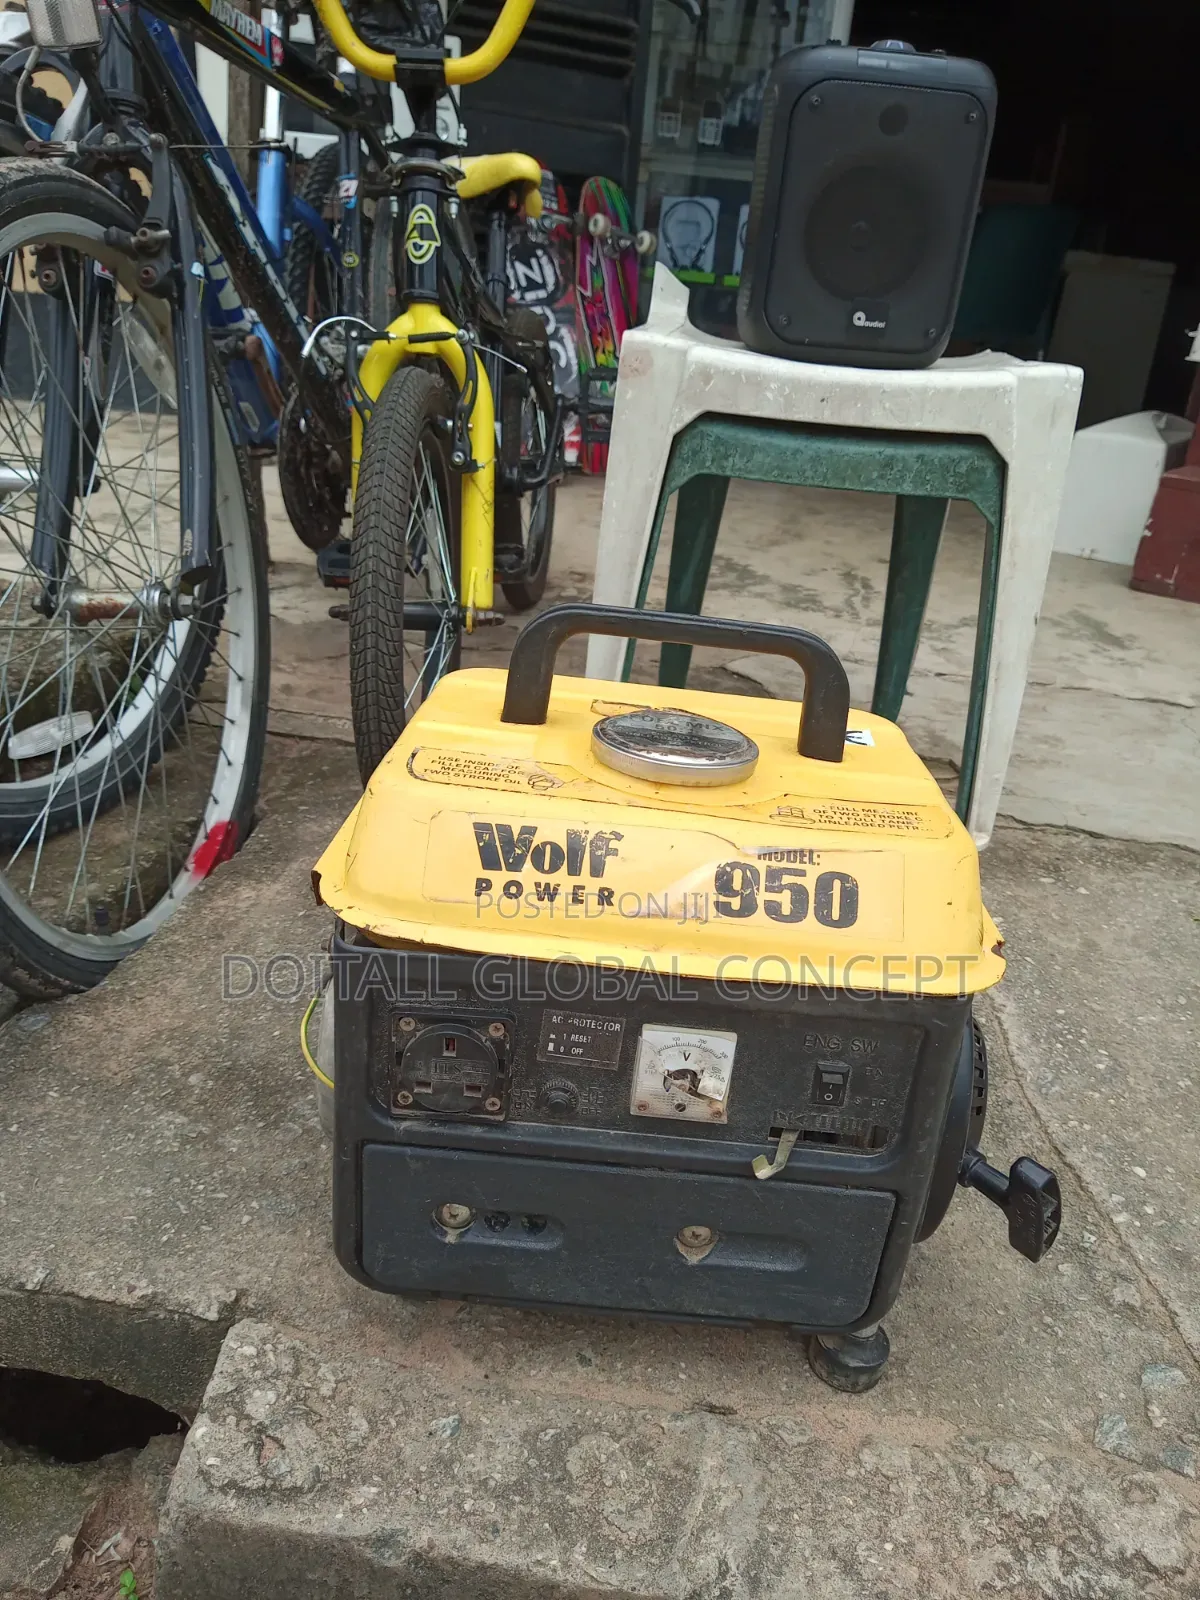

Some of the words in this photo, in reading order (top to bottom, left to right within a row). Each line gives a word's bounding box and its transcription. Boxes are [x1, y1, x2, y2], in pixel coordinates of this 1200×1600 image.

[430, 759, 471, 769] FILLER
[438, 755, 461, 763] USE
[423, 768, 451, 776] TWO
[454, 773, 500, 783] STROKE
[440, 766, 510, 779] MEASURING
[832, 810, 863, 818] TWO
[865, 812, 913, 821] STROKE
[844, 816, 879, 824] FULL
[818, 819, 886, 829] UNLEADED
[474, 877, 615, 906] POWER
[713, 861, 859, 929] 950
[551, 1015, 564, 1023] AC
[570, 1034, 592, 1043] RESET
[804, 1033, 841, 1049] ENG
[851, 1039, 879, 1052] SW
[571, 1047, 584, 1055] OFF
[683, 1052, 692, 1062] V
